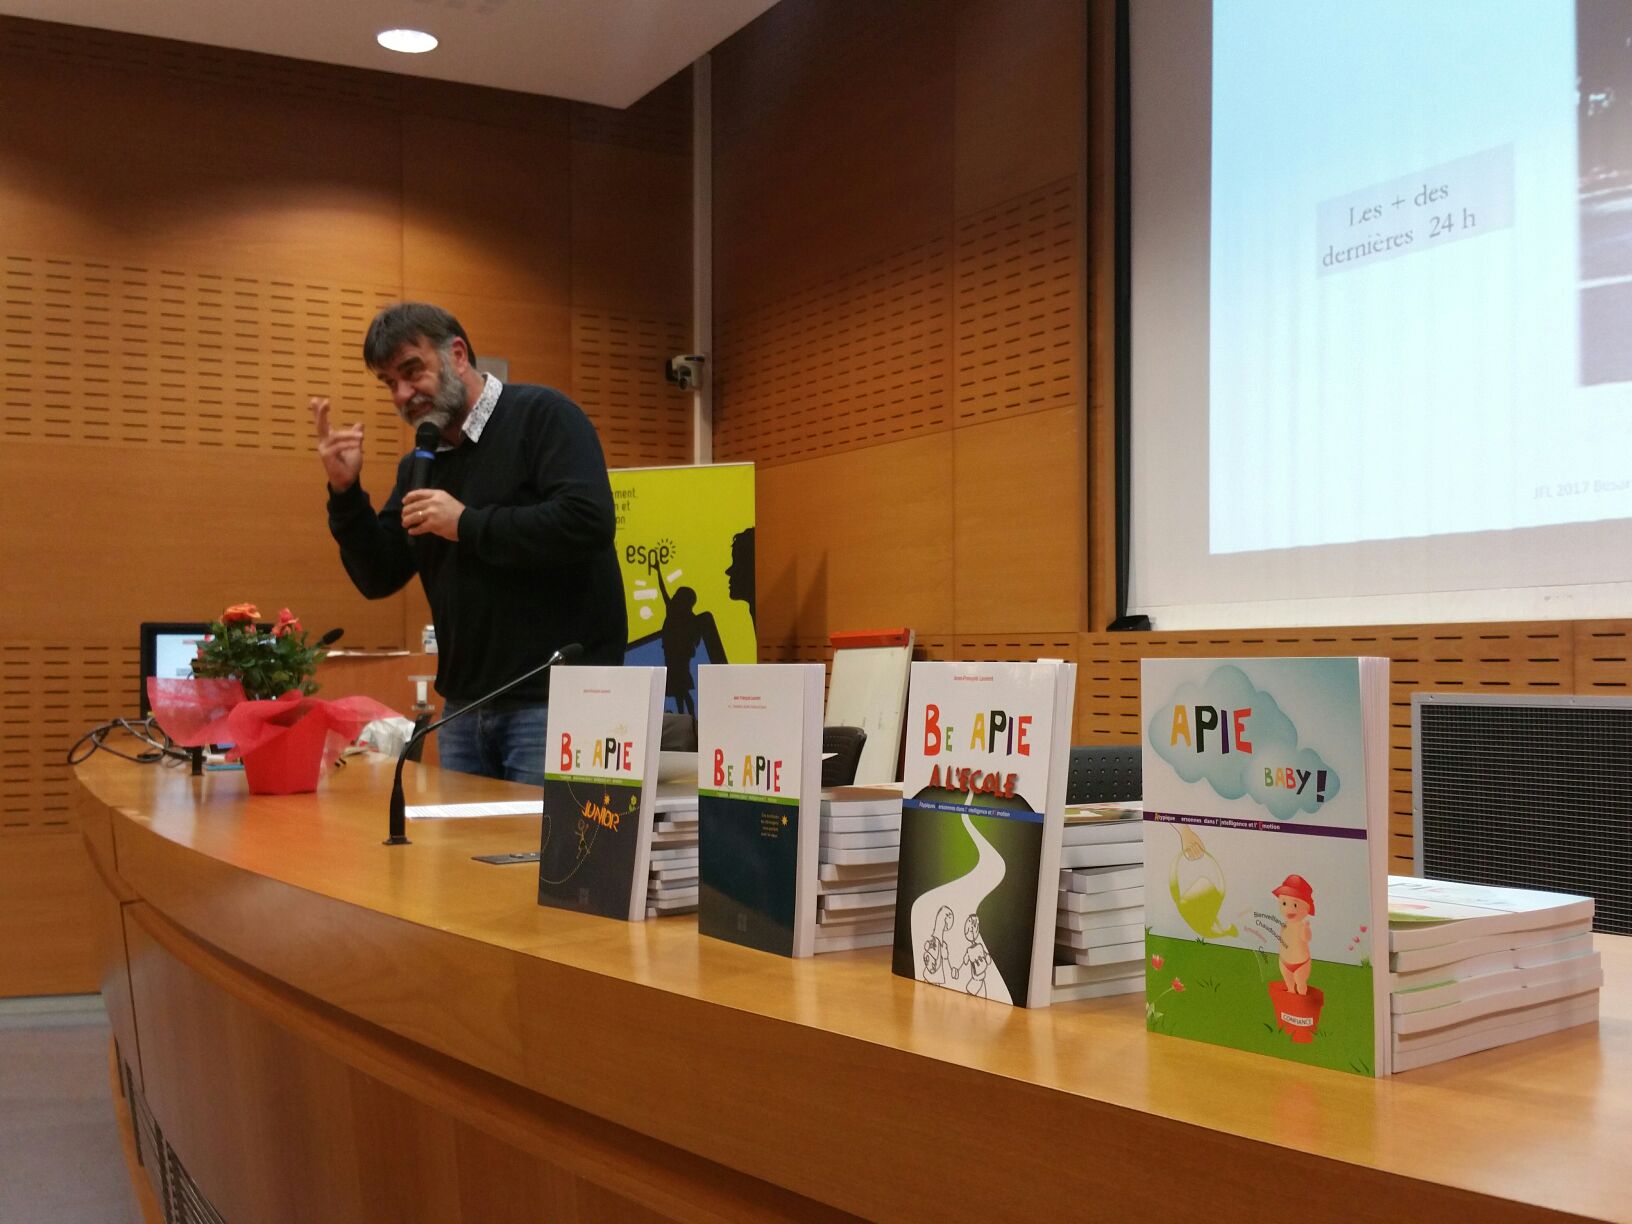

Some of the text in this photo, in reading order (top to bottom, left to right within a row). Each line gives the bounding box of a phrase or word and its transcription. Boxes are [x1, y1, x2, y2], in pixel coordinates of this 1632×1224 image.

[1348, 204, 1383, 227] Les
[1413, 183, 1449, 207] des
[1322, 207, 1477, 267] dernières 24 h
[1556, 481, 1589, 497] 2017
[970, 710, 1033, 757] APIE
[1170, 704, 1253, 755] APIE
[592, 737, 633, 771] APIE
[742, 755, 783, 793] APIE
[929, 763, 941, 790] A
[581, 799, 620, 833] JUNIOR
[1203, 817, 1215, 825] dans
